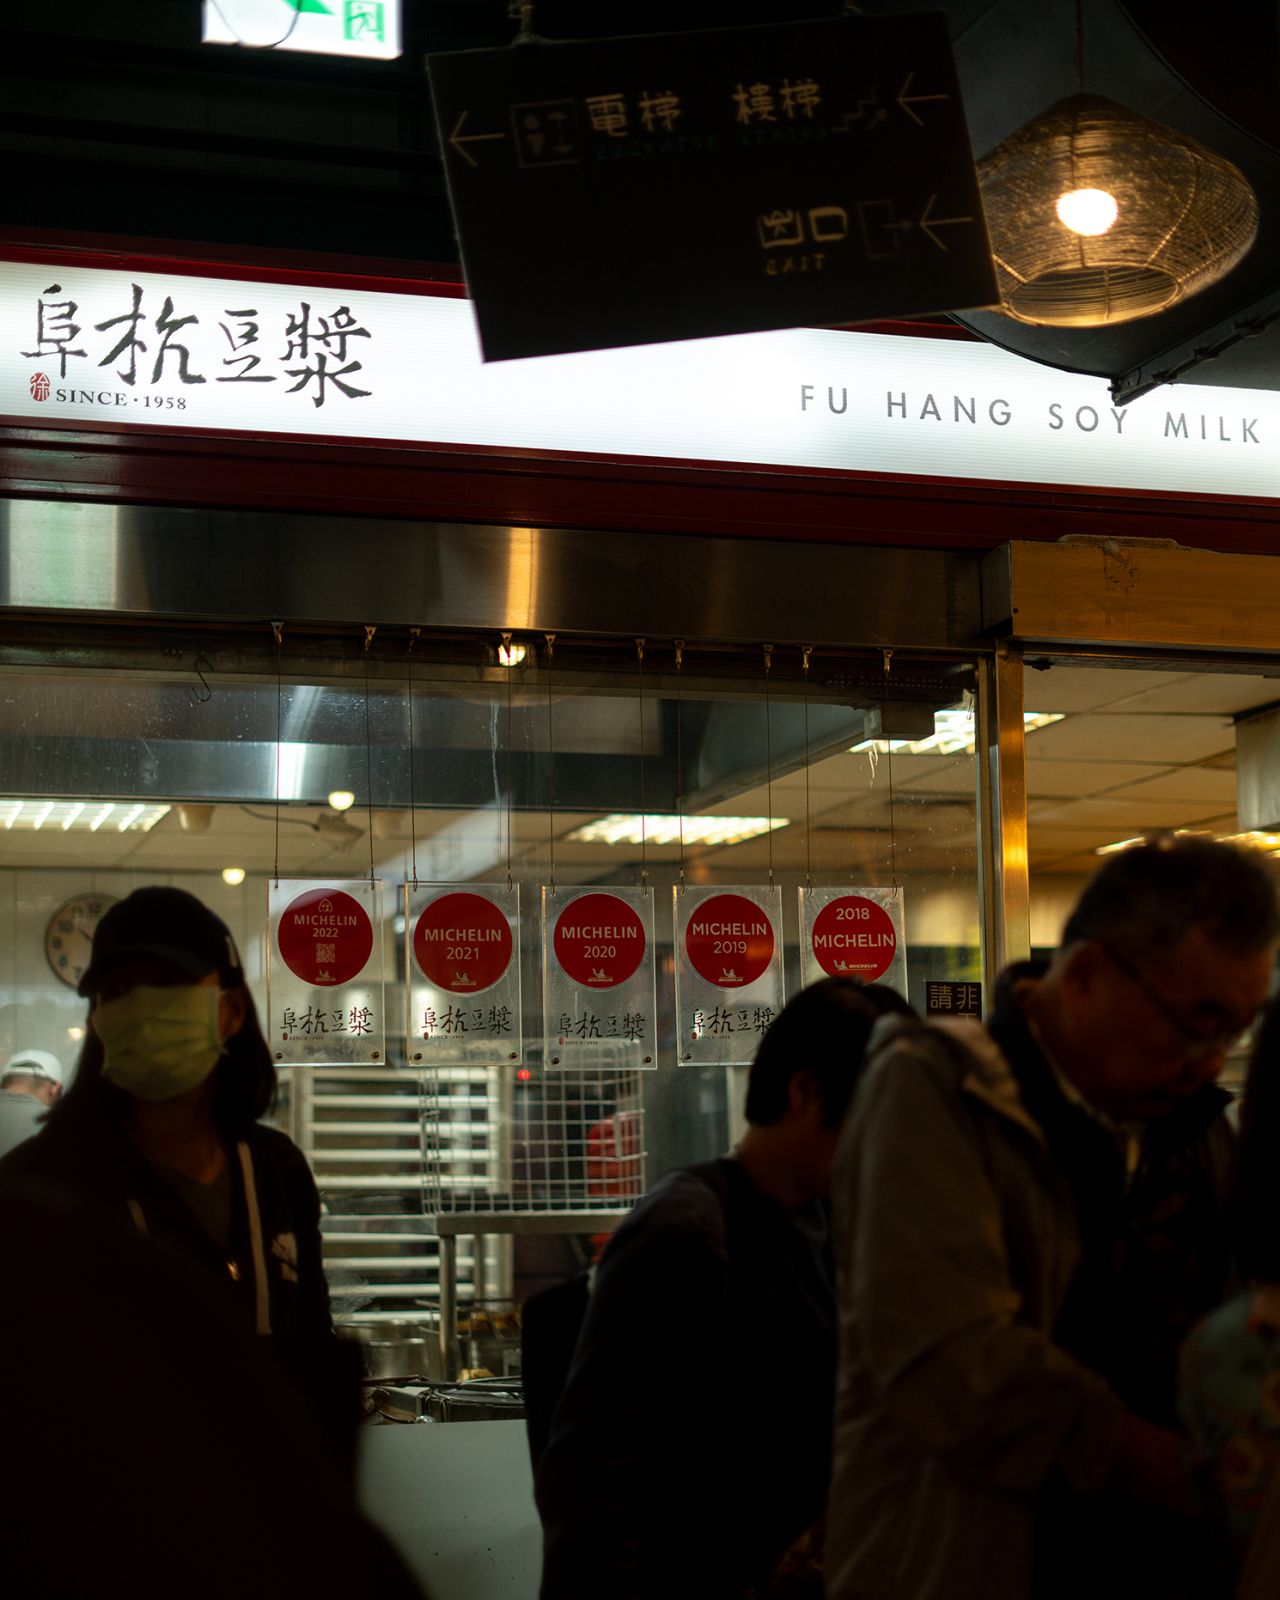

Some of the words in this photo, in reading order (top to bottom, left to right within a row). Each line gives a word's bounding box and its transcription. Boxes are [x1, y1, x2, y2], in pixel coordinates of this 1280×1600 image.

[584, 90, 682, 137] 電梯
[730, 78, 823, 125] 樓梯
[757, 205, 849, 250] 出口
[766, 252, 827, 277] EXIT
[20, 283, 373, 409] 阜杭豆漿
[800, 384, 848, 414] FU
[887, 391, 1012, 426] HANG
[1048, 403, 1128, 434] SOY
[1164, 411, 1260, 444] MILK
[294, 914, 358, 926] MICHELIN
[835, 907, 870, 921] 2018
[312, 927, 339, 938] 2022
[425, 928, 502, 942] MICHELIN
[561, 925, 637, 939] MICHELIN
[692, 922, 767, 937] MICHELIN
[713, 940, 747, 954] 2019
[814, 933, 894, 949] MICHELIN
[446, 947, 480, 960] 2021
[583, 945, 617, 959] 2020
[930, 985, 953, 1009] 請
[280, 1005, 374, 1036] 阜杭豆漿
[421, 1005, 513, 1034] 阜杭豆漿
[557, 1011, 646, 1041] 阜杭豆漿
